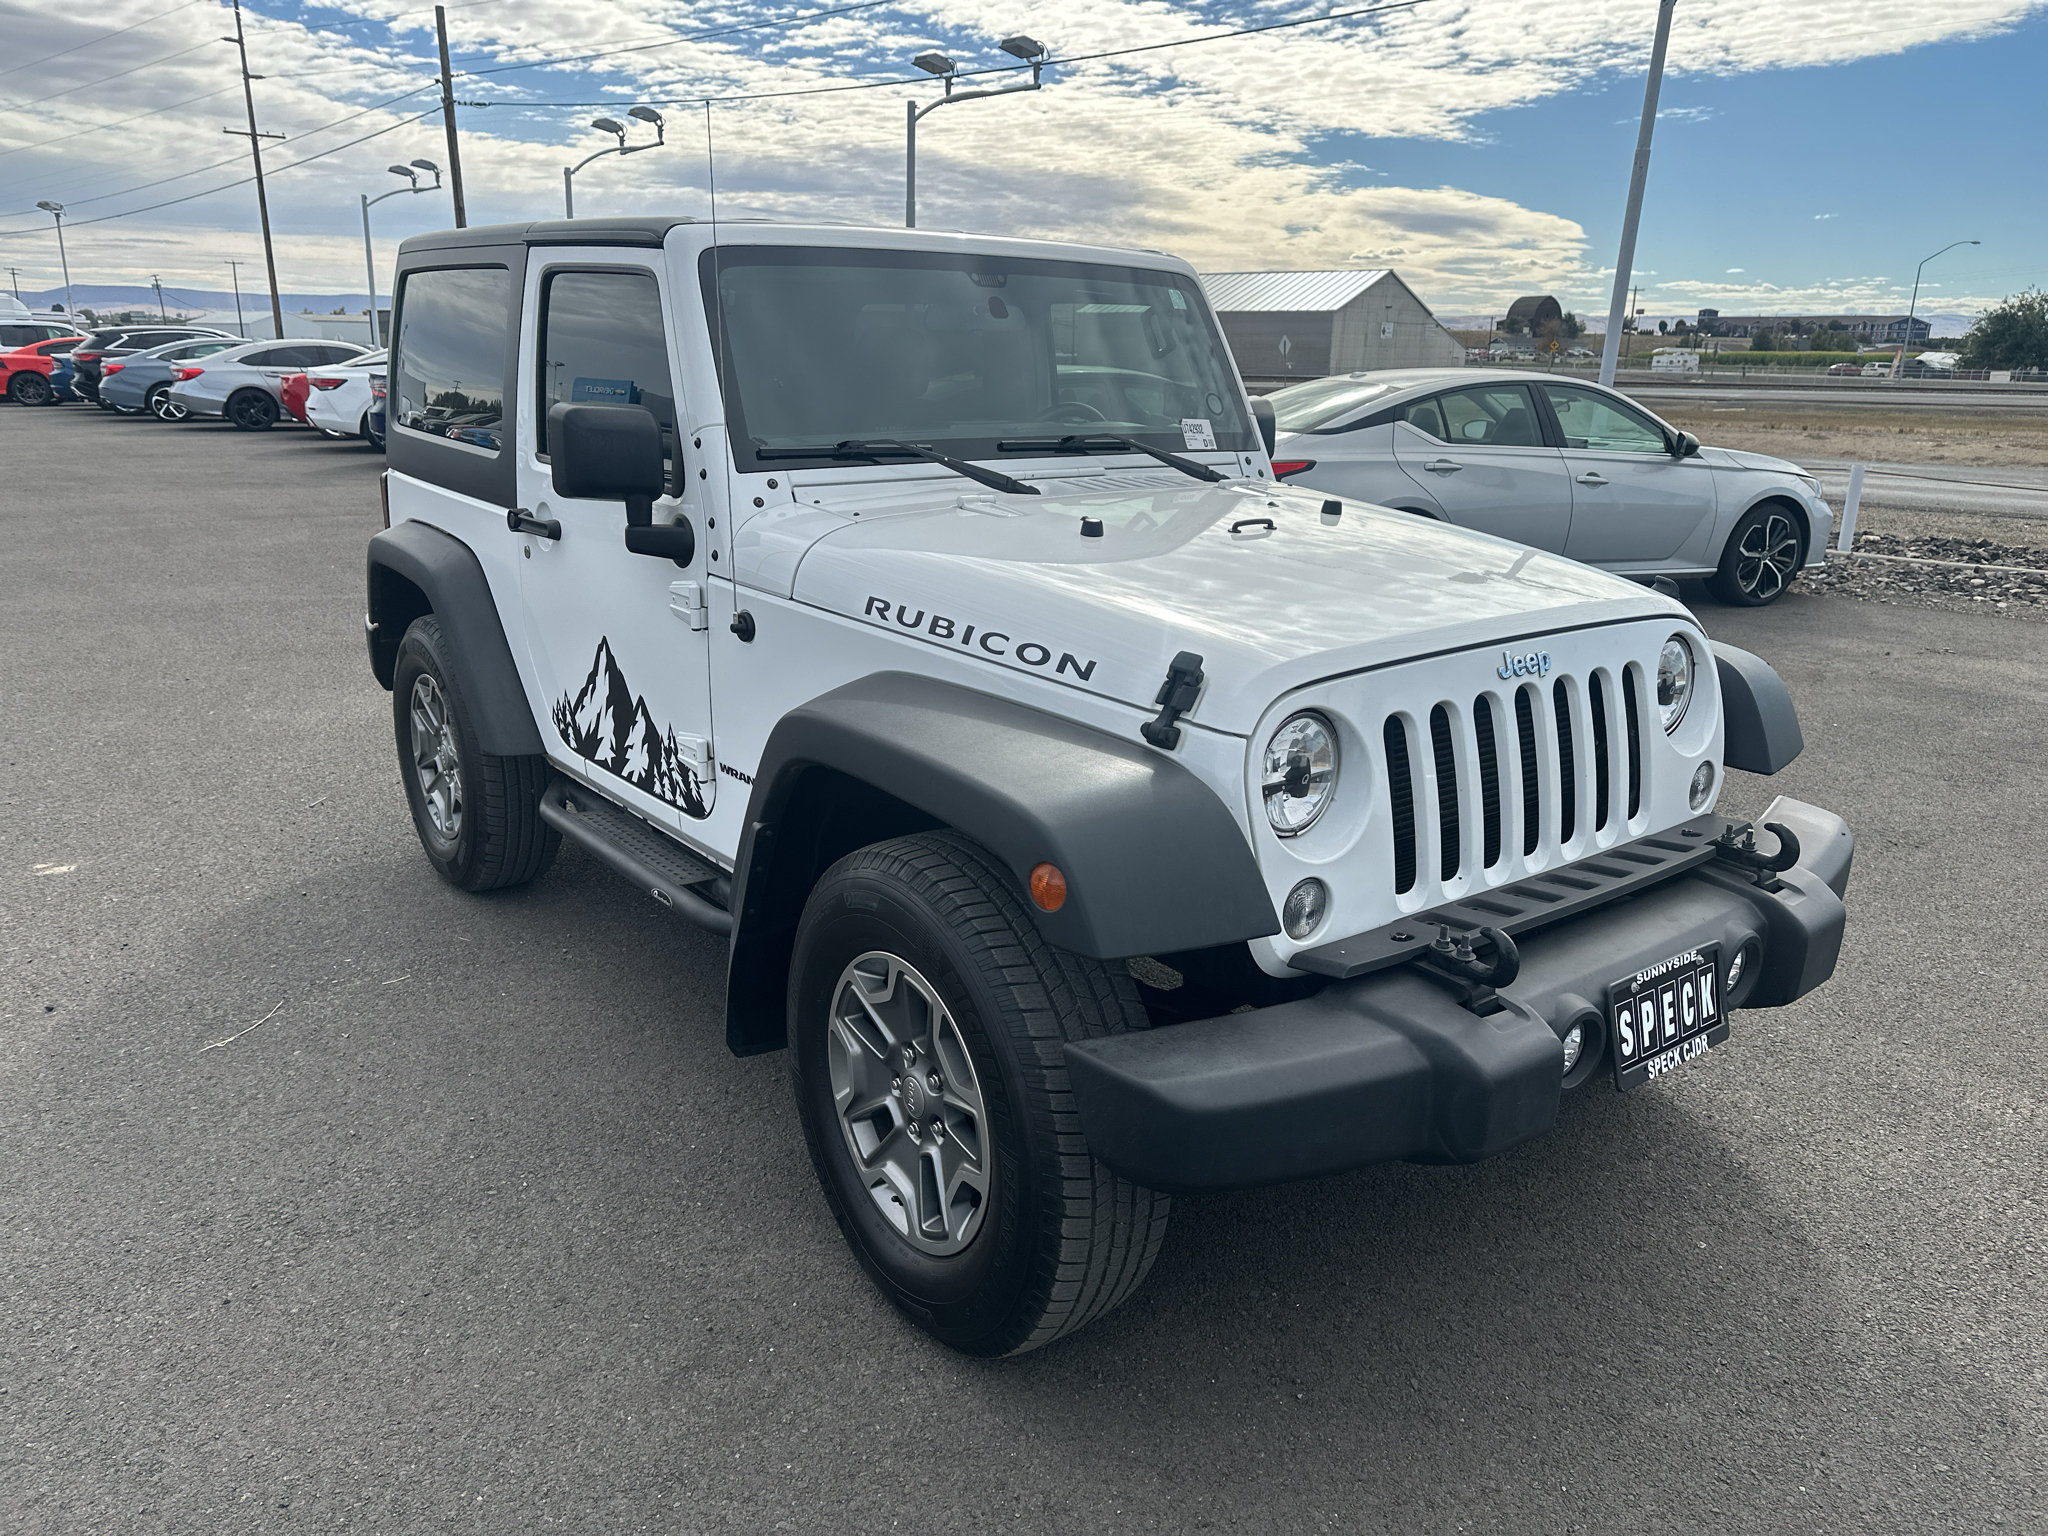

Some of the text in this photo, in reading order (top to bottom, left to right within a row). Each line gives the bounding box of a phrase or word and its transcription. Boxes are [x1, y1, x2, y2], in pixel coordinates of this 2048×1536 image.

[864, 595, 1097, 682] RUBICON
[1497, 649, 1552, 680] Jeep
[719, 761, 755, 786] WRAN
[1636, 951, 1698, 985] SUNNYSIDE
[1619, 972, 1715, 1057] SPECK
[1647, 1034, 1709, 1080] SPECK CJDR
